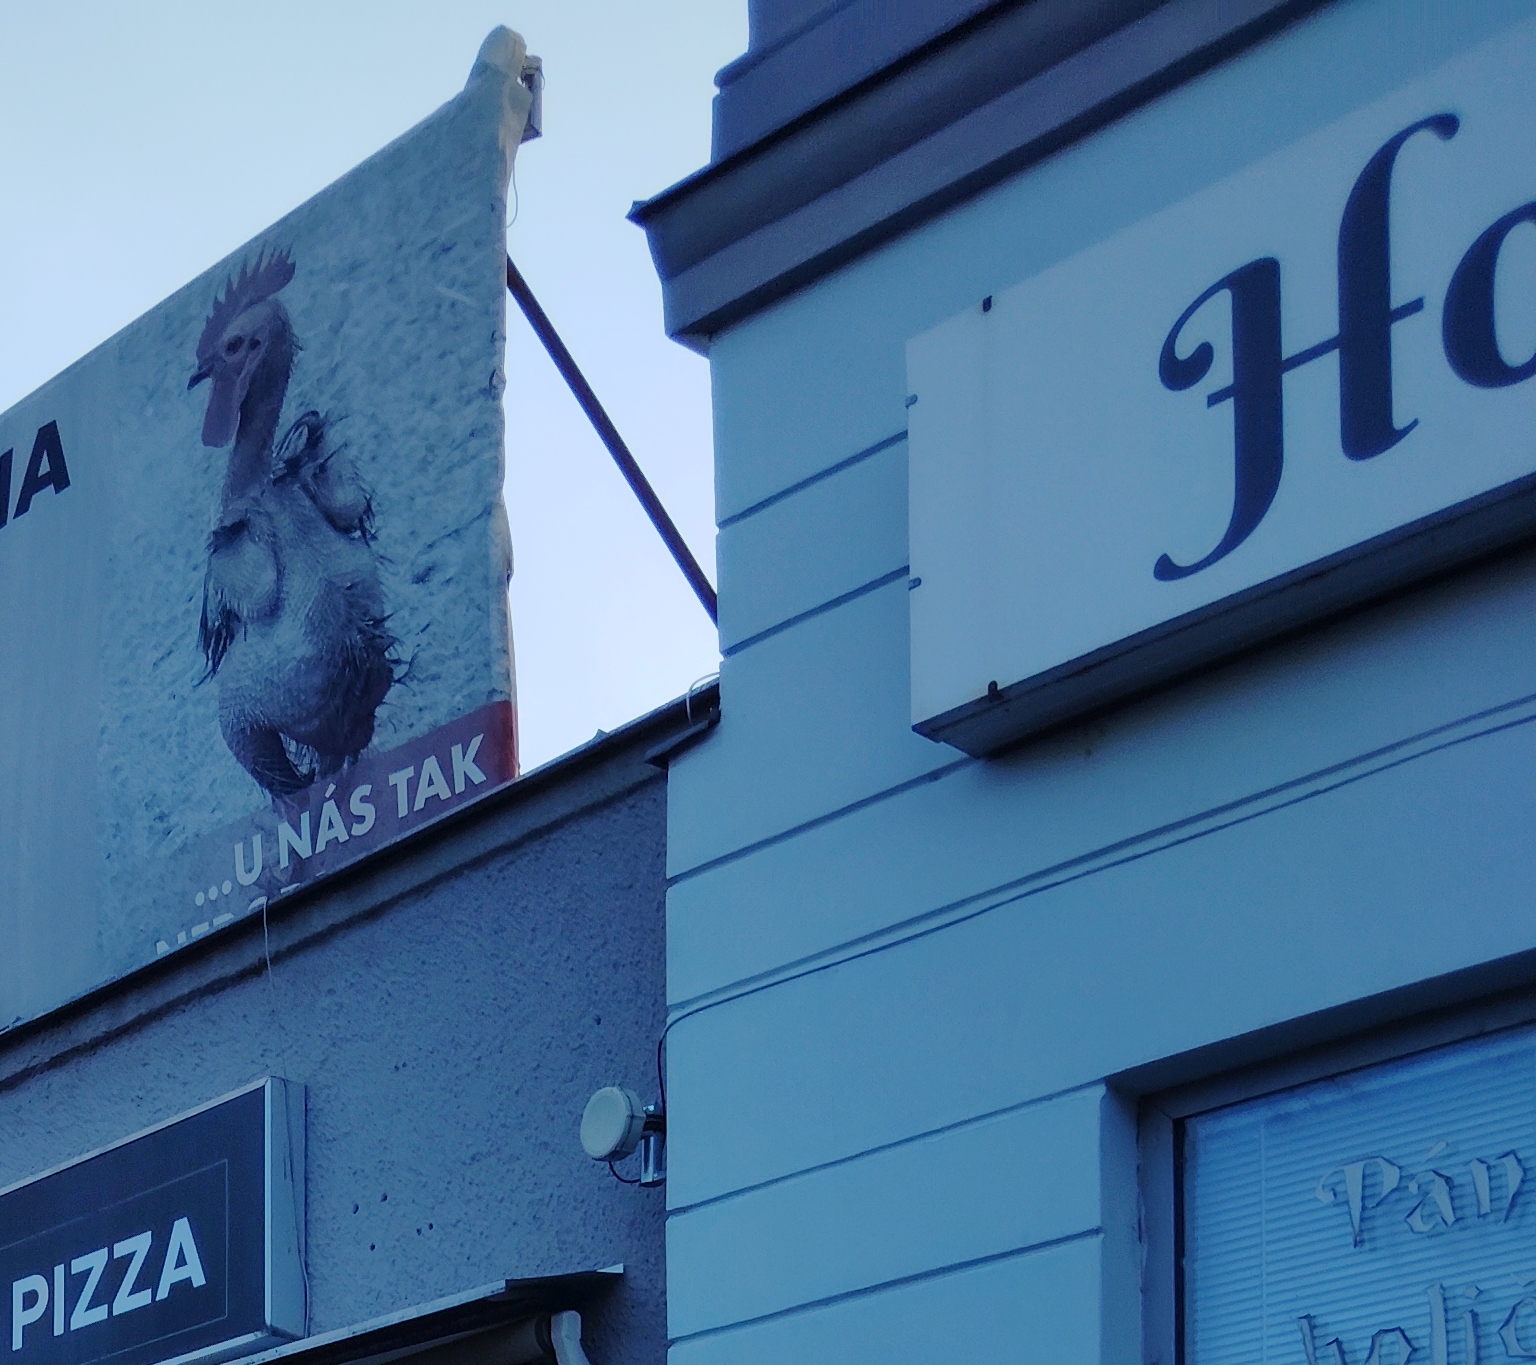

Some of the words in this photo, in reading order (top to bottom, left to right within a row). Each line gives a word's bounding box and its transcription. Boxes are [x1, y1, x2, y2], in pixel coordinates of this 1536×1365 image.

[278, 783, 376, 869] NÁS
[389, 733, 486, 818] TAK
[11, 1216, 206, 1352] PIZZA
